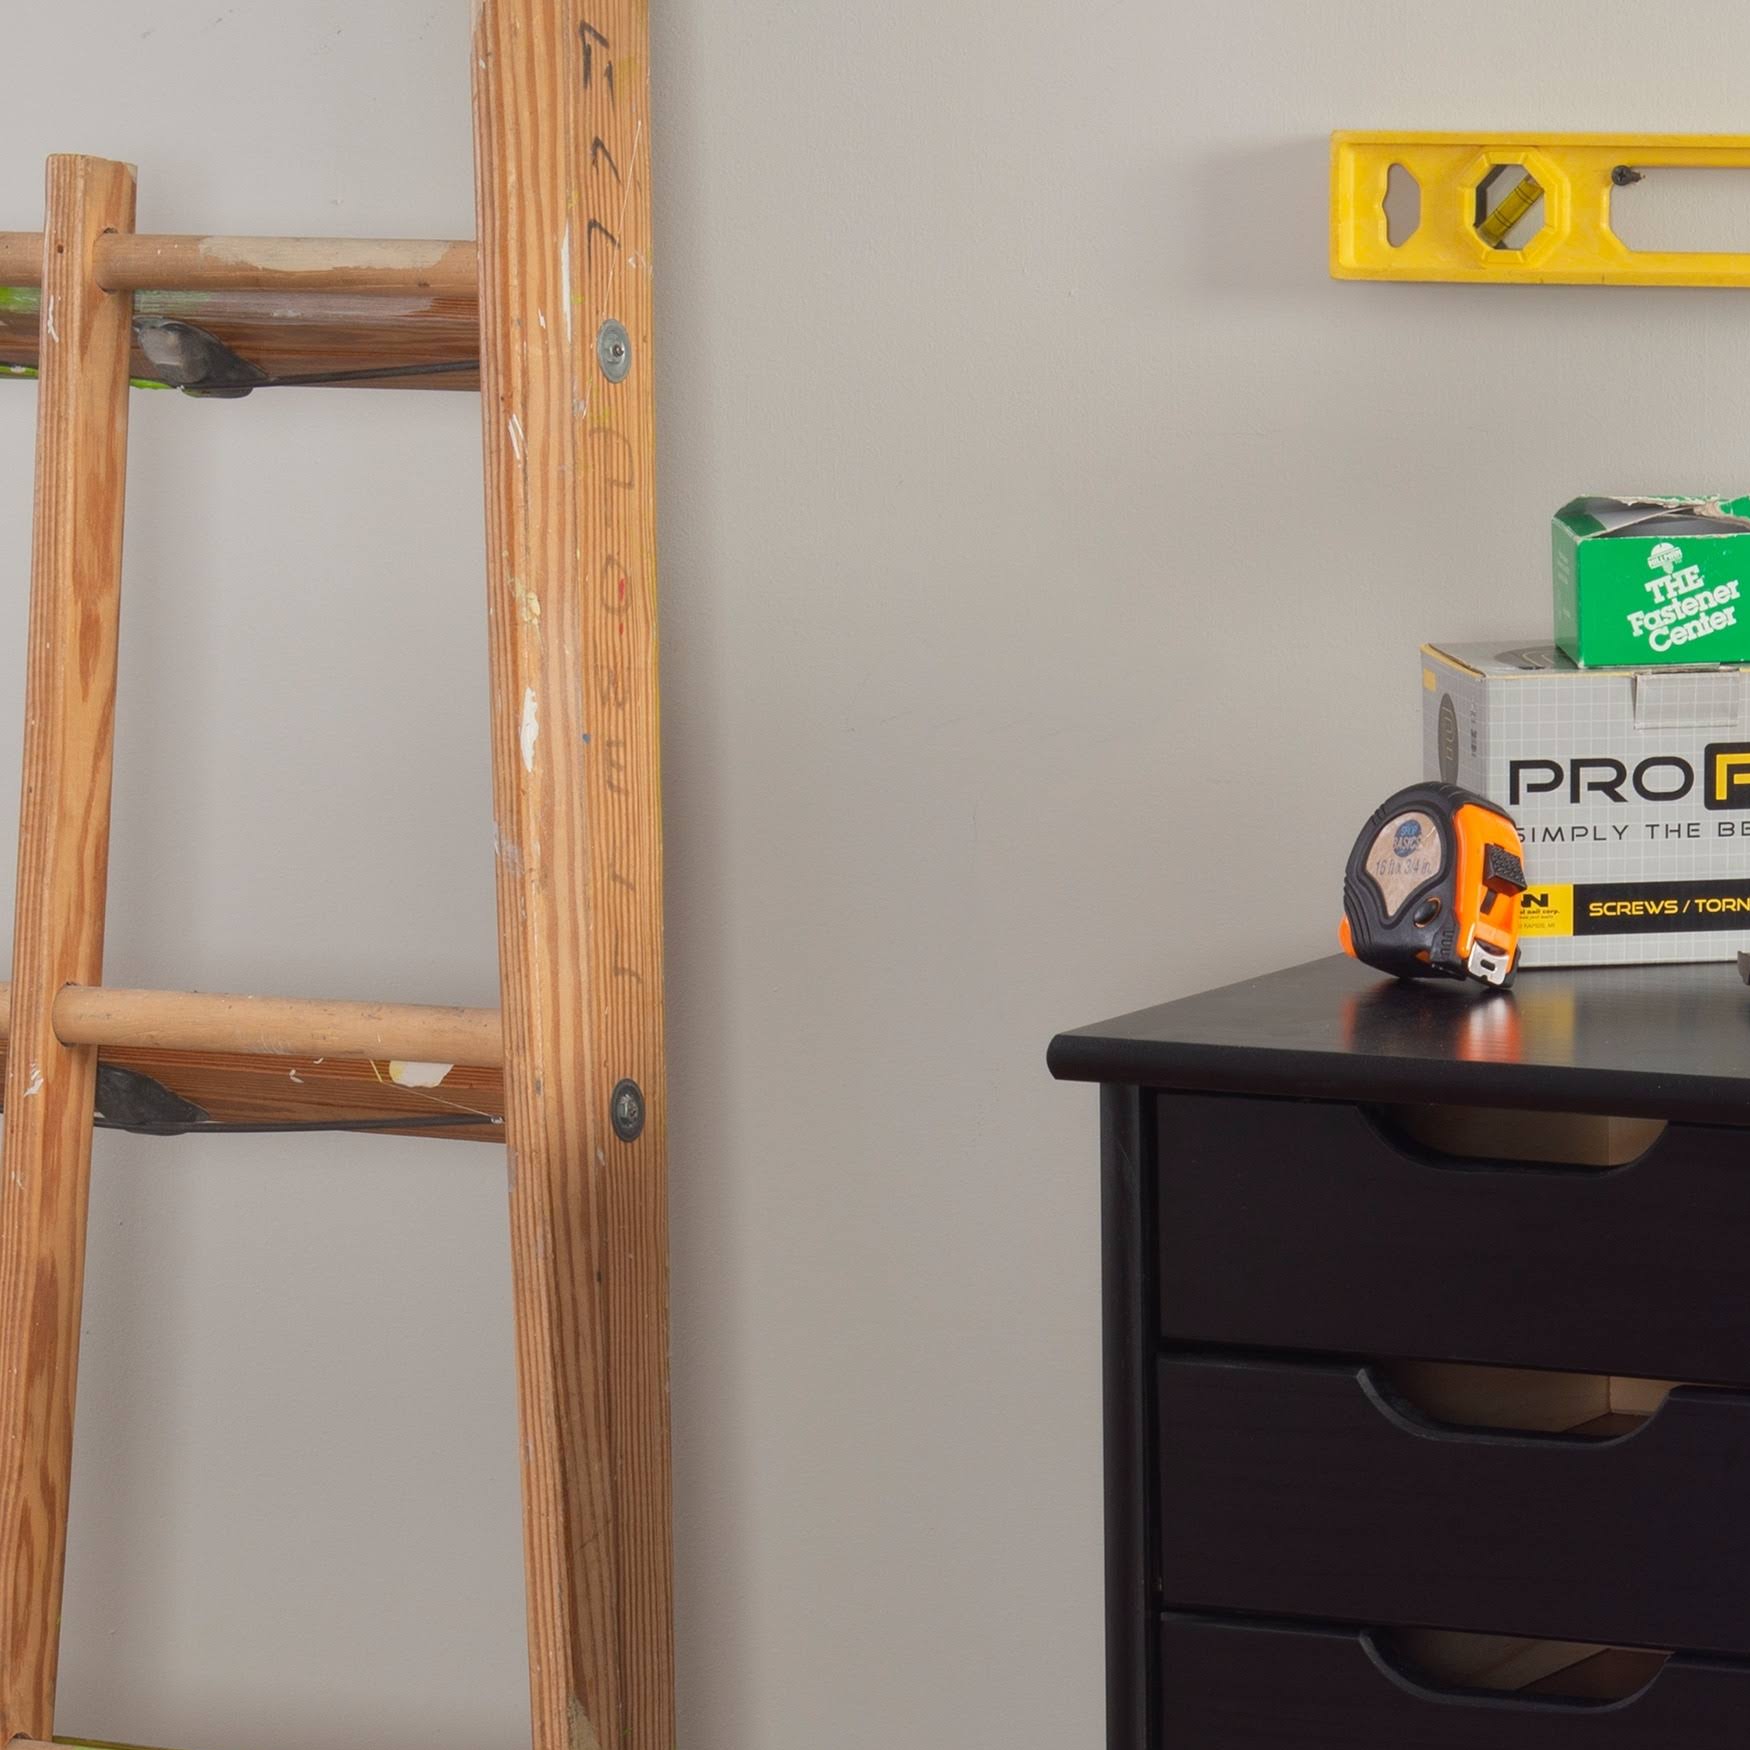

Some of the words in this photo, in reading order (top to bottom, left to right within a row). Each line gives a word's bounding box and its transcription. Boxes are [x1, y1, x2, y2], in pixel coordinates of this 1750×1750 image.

[1644, 564, 1705, 604] THE
[1626, 579, 1741, 637] Fastener
[1648, 606, 1737, 652] Center
[1517, 824, 1630, 843] SIMPLY
[1645, 822, 1702, 840] THE
[1588, 899, 1679, 917] SCREWS
